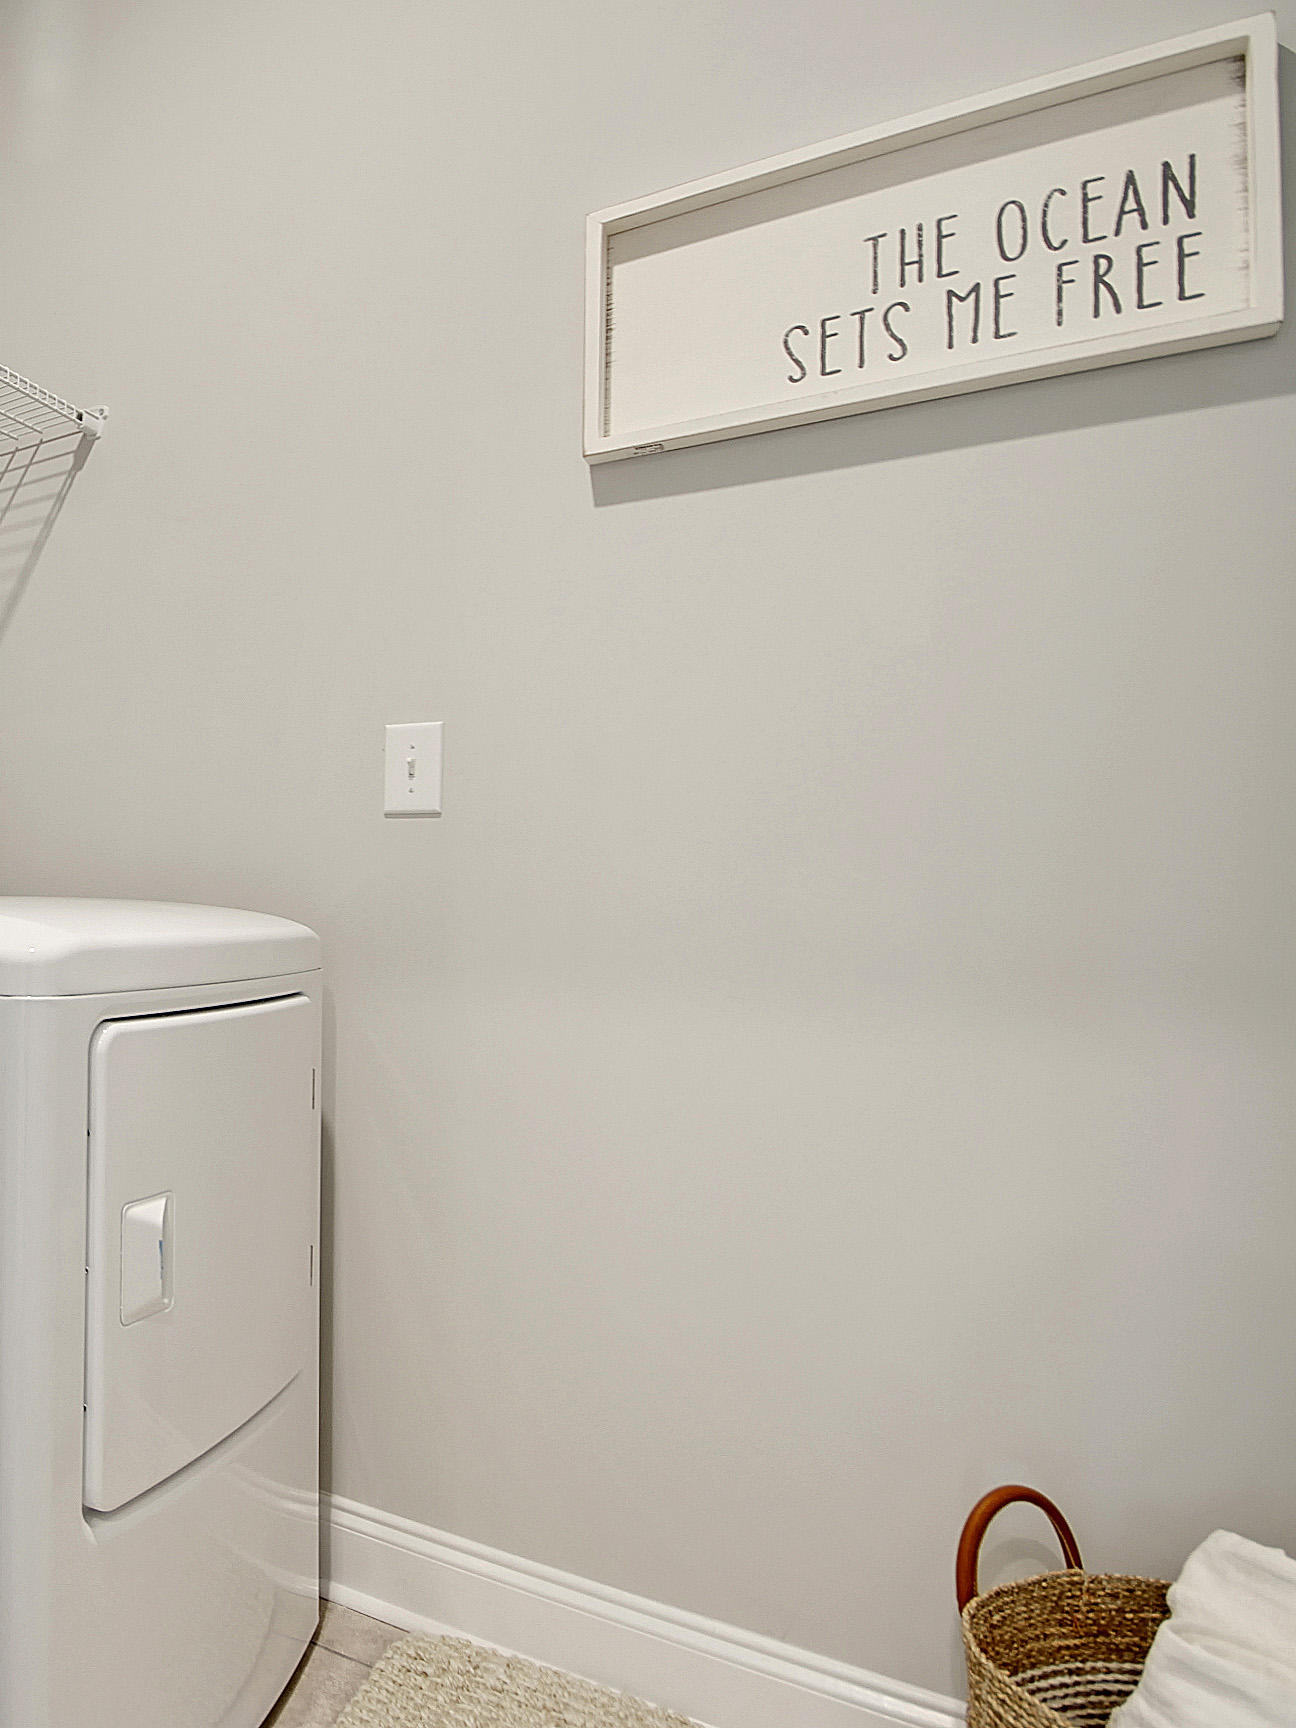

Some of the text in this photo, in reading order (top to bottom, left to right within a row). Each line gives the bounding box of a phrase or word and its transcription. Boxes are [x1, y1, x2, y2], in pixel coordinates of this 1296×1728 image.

[863, 153, 1197, 295] THE OCEAN
[782, 231, 1206, 384] SETS ME FREE
